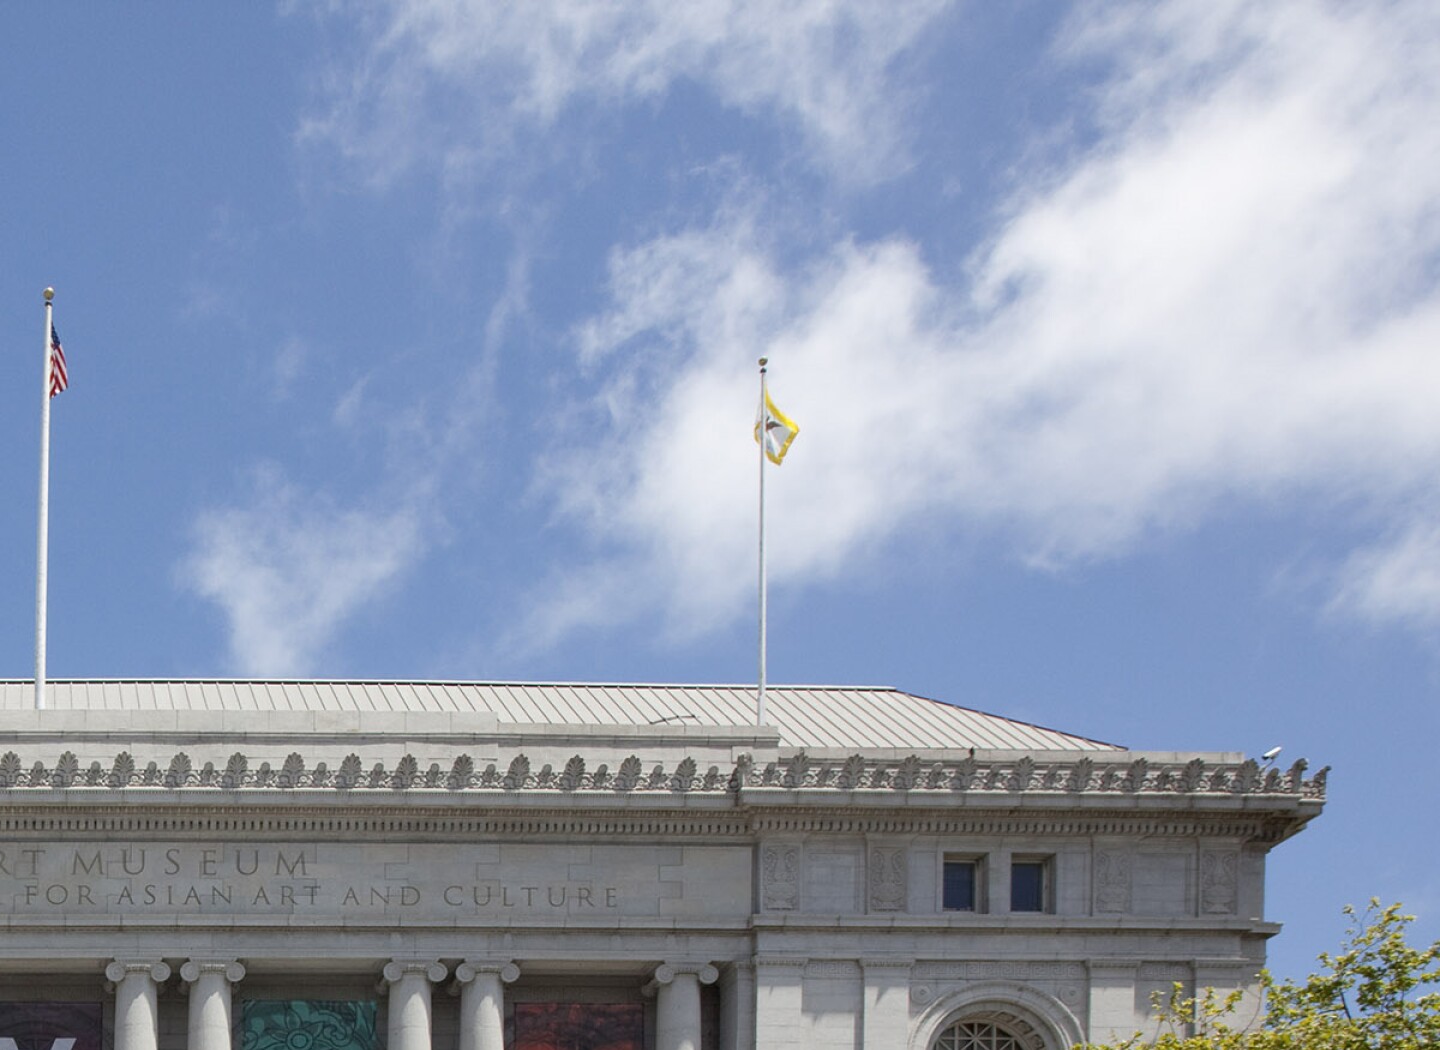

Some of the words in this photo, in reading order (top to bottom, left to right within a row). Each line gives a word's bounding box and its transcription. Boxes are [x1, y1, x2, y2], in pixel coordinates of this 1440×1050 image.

[71, 848, 308, 877] MUSEUM
[25, 884, 97, 906] FOR
[116, 884, 233, 906] ASIAN
[252, 885, 321, 906] ART
[342, 885, 421, 908] AND
[443, 884, 618, 908] CULTURE
